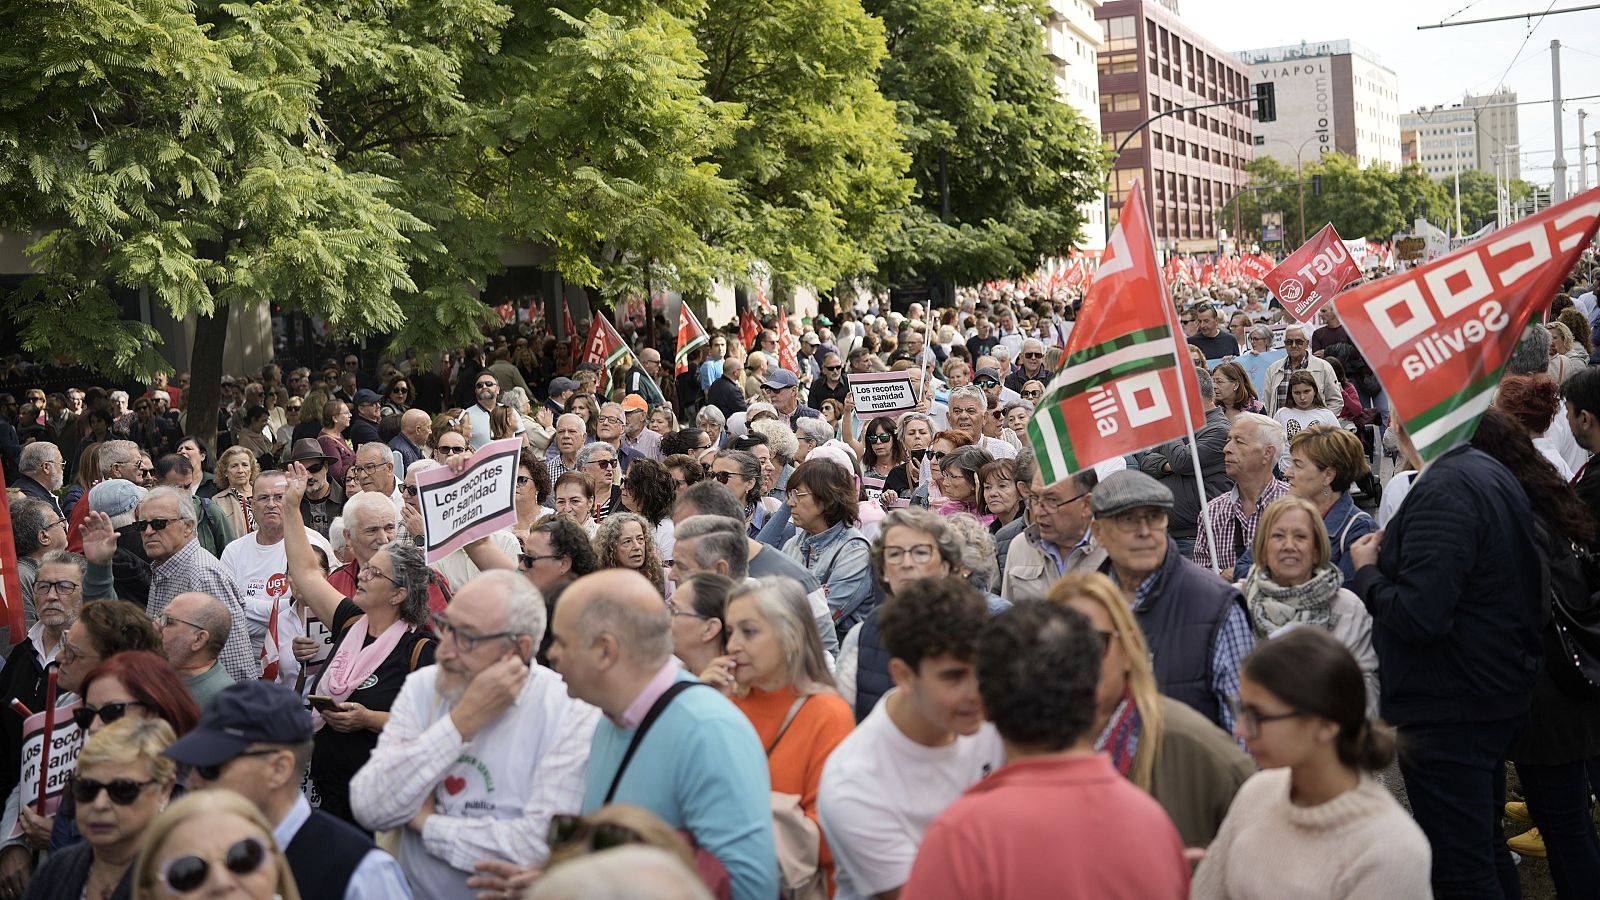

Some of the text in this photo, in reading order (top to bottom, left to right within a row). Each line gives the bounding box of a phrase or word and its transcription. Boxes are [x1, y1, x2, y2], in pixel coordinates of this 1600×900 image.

[1261, 64, 1326, 79] VIAPOL
[1314, 78, 1329, 160] celo.com
[856, 384, 905, 394] Los recortes
[872, 391, 904, 401] sanidad
[871, 401, 897, 409] matan
[434, 464, 503, 507] Los recortes
[442, 478, 497, 521] en sanidad
[452, 503, 483, 530] matan
[268, 578, 286, 589] UGT
[246, 589, 256, 597] NO
[22, 743, 41, 766] Los
[24, 764, 35, 783] en
